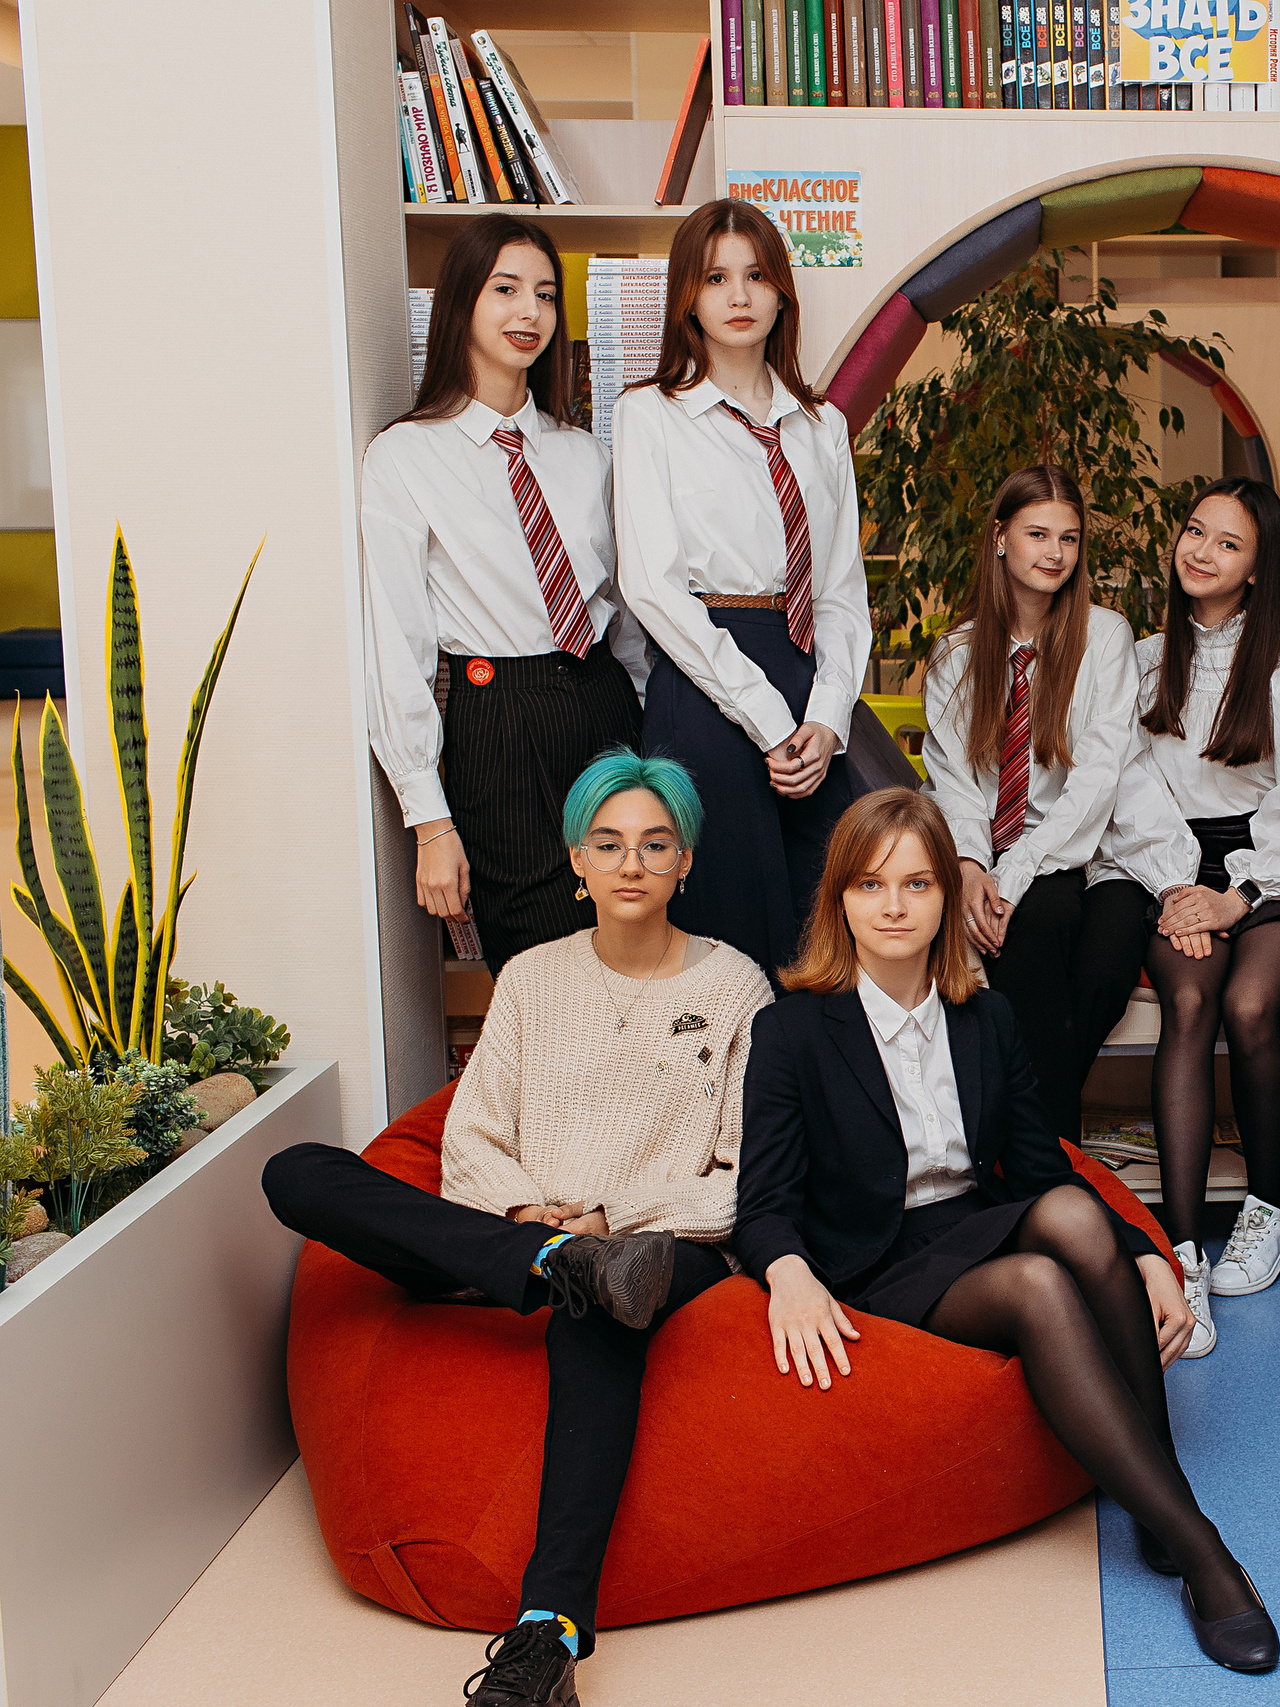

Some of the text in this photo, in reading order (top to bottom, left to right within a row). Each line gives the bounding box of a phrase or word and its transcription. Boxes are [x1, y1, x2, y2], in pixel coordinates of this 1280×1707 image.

[888, 2, 896, 42] ПОЛКОВОДЦЕВ
[434, 41, 451, 77] Чудеса
[1149, 36, 1234, 82] ВСЕ
[435, 95, 443, 109] ВСЕ
[439, 110, 450, 135] ЧУДЕСА
[445, 135, 454, 157] СВЕТА
[471, 98, 495, 158] ВСЕ ЧУДЕСА СВЕТА
[485, 91, 515, 159] ЧУДЕСНЫЕ КАМНИ
[411, 106, 438, 193] Я ПОЗНАЮ МИР
[728, 178, 860, 202] внеКЛАССНОЕ
[779, 210, 857, 232] ЧТЕНИЕ
